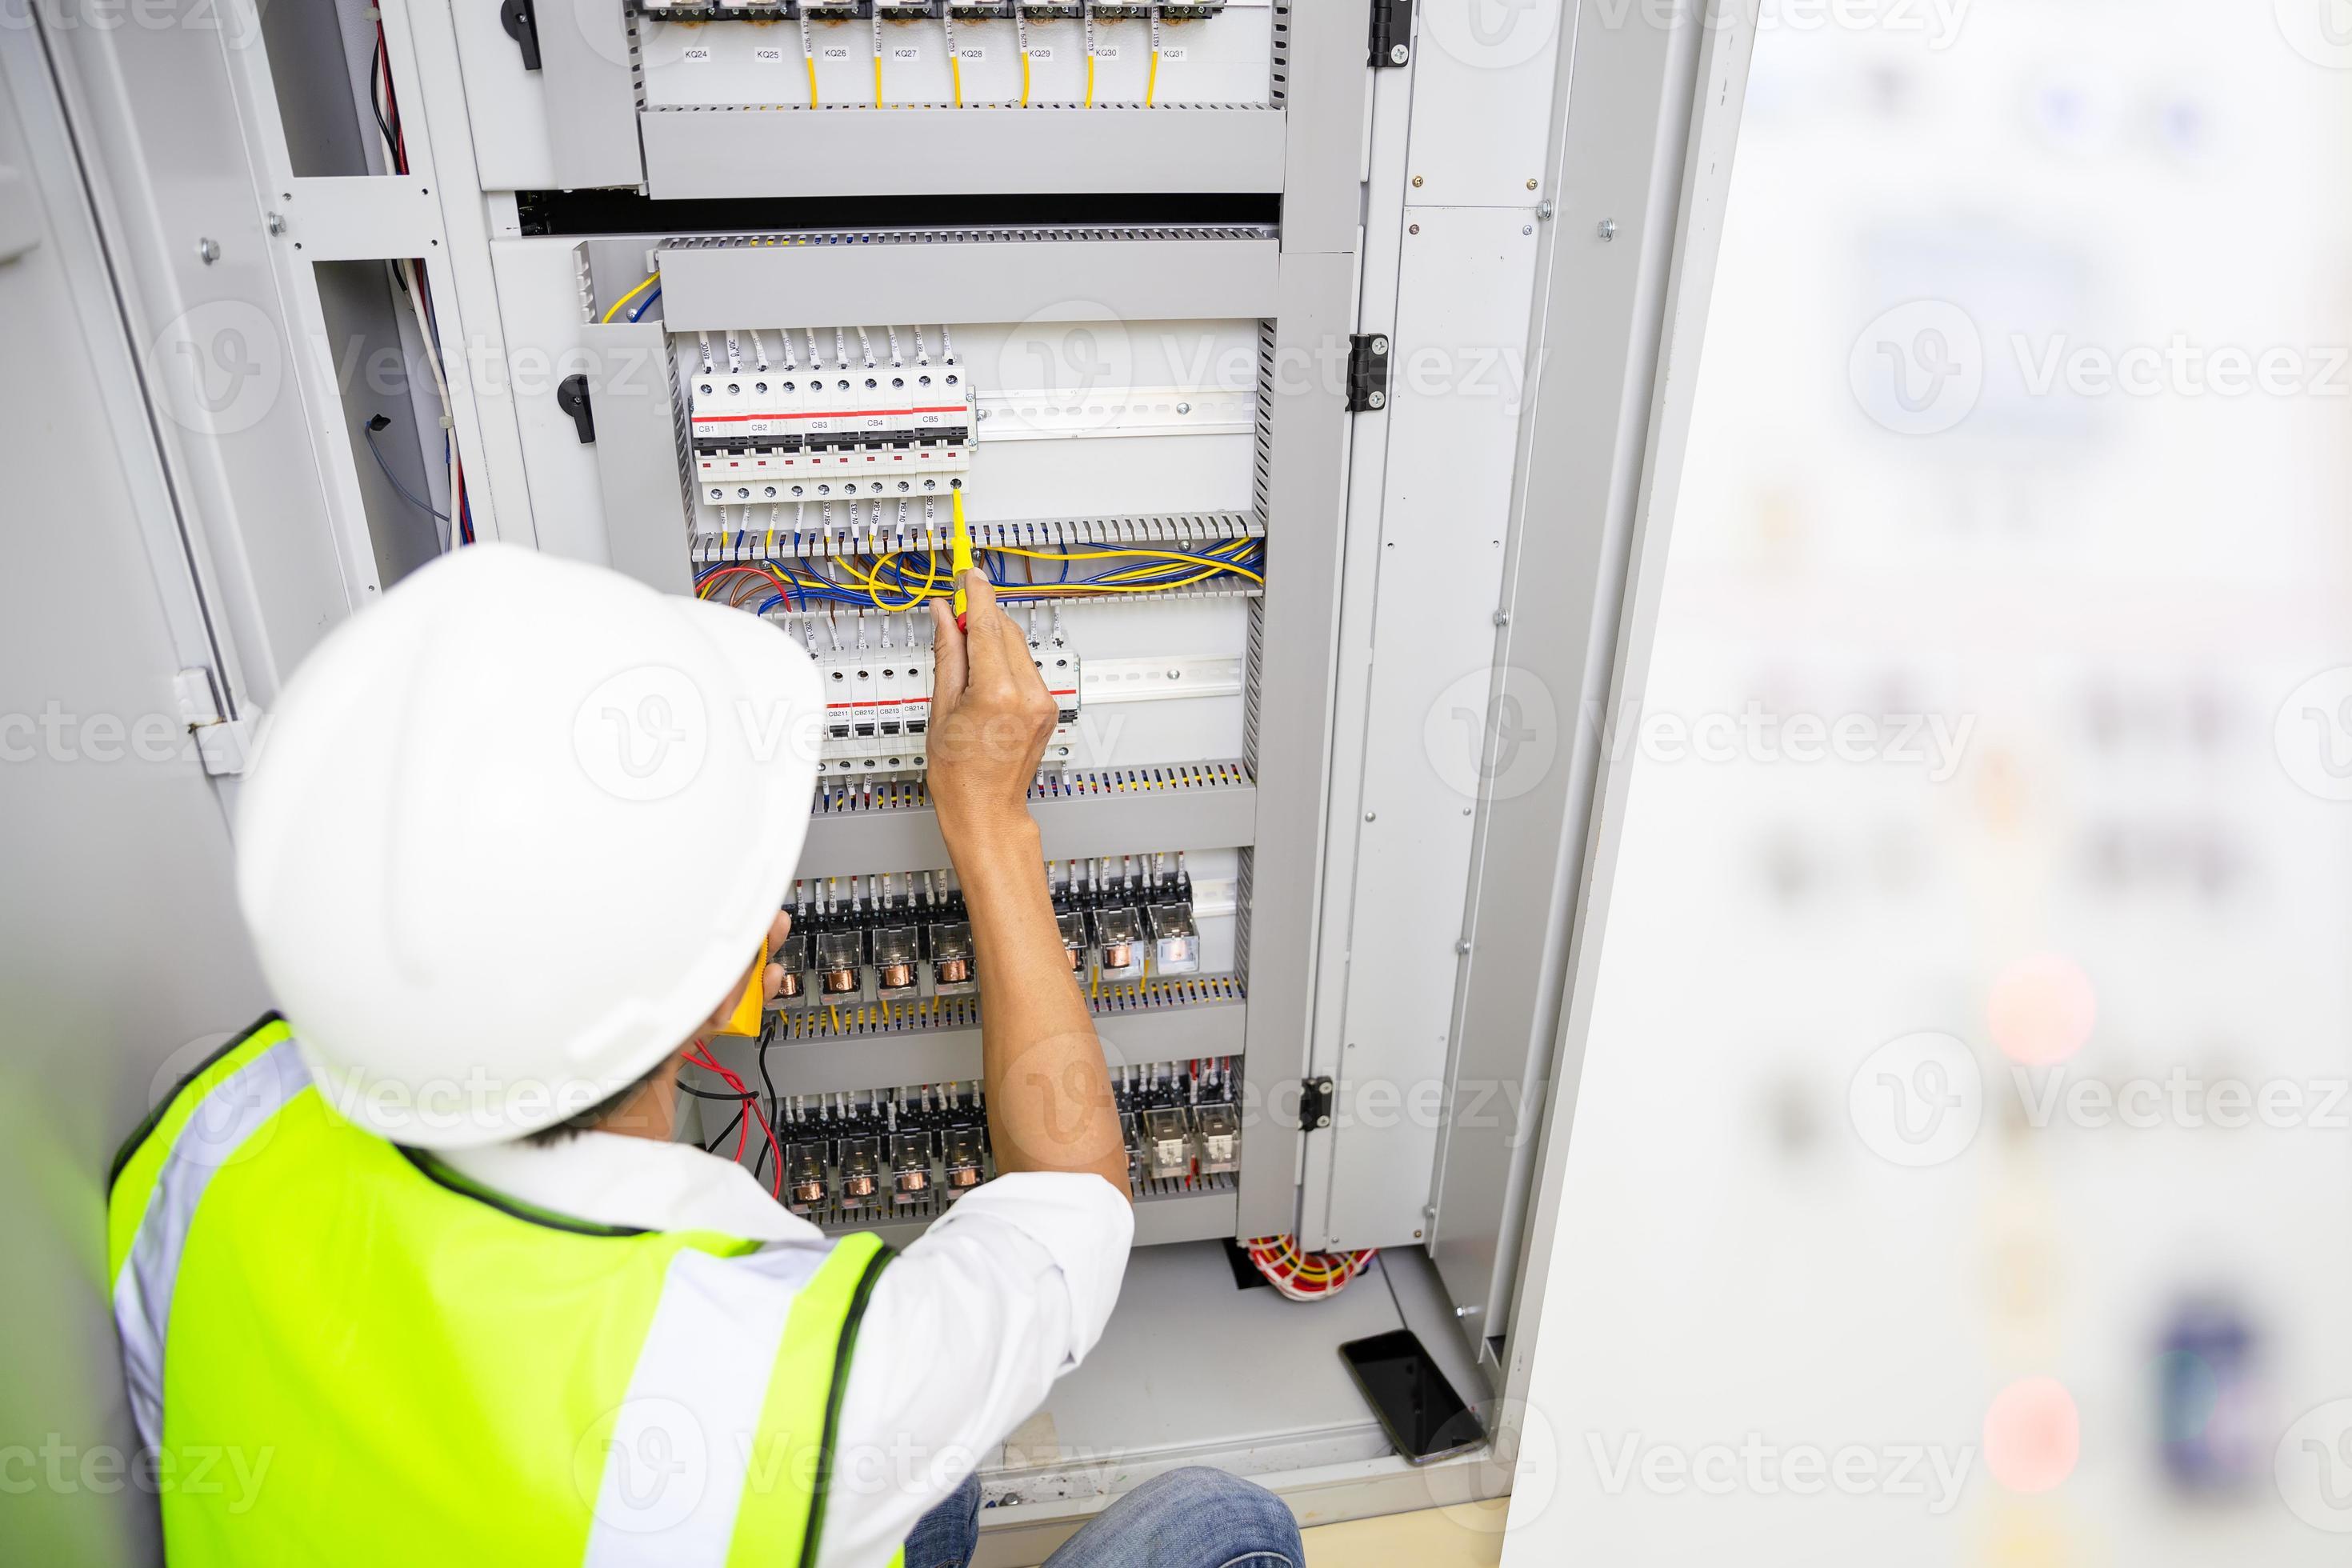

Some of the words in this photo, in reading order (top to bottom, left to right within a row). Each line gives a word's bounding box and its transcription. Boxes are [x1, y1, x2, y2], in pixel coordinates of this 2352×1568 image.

[685, 50, 707, 59] KQ24
[757, 50, 779, 59] KQ25
[825, 50, 846, 58] KQ26
[895, 50, 916, 58] KQ27
[962, 50, 982, 58] KQ28
[1029, 49, 1050, 58] KQ29
[1096, 49, 1117, 58] KQ30
[1164, 50, 1184, 58] KQ31
[700, 342, 710, 360] 48VDC
[926, 495, 934, 518] 48V-CB5
[871, 501, 880, 525] 48V-CB4
[899, 502, 907, 522] 0V-CB4
